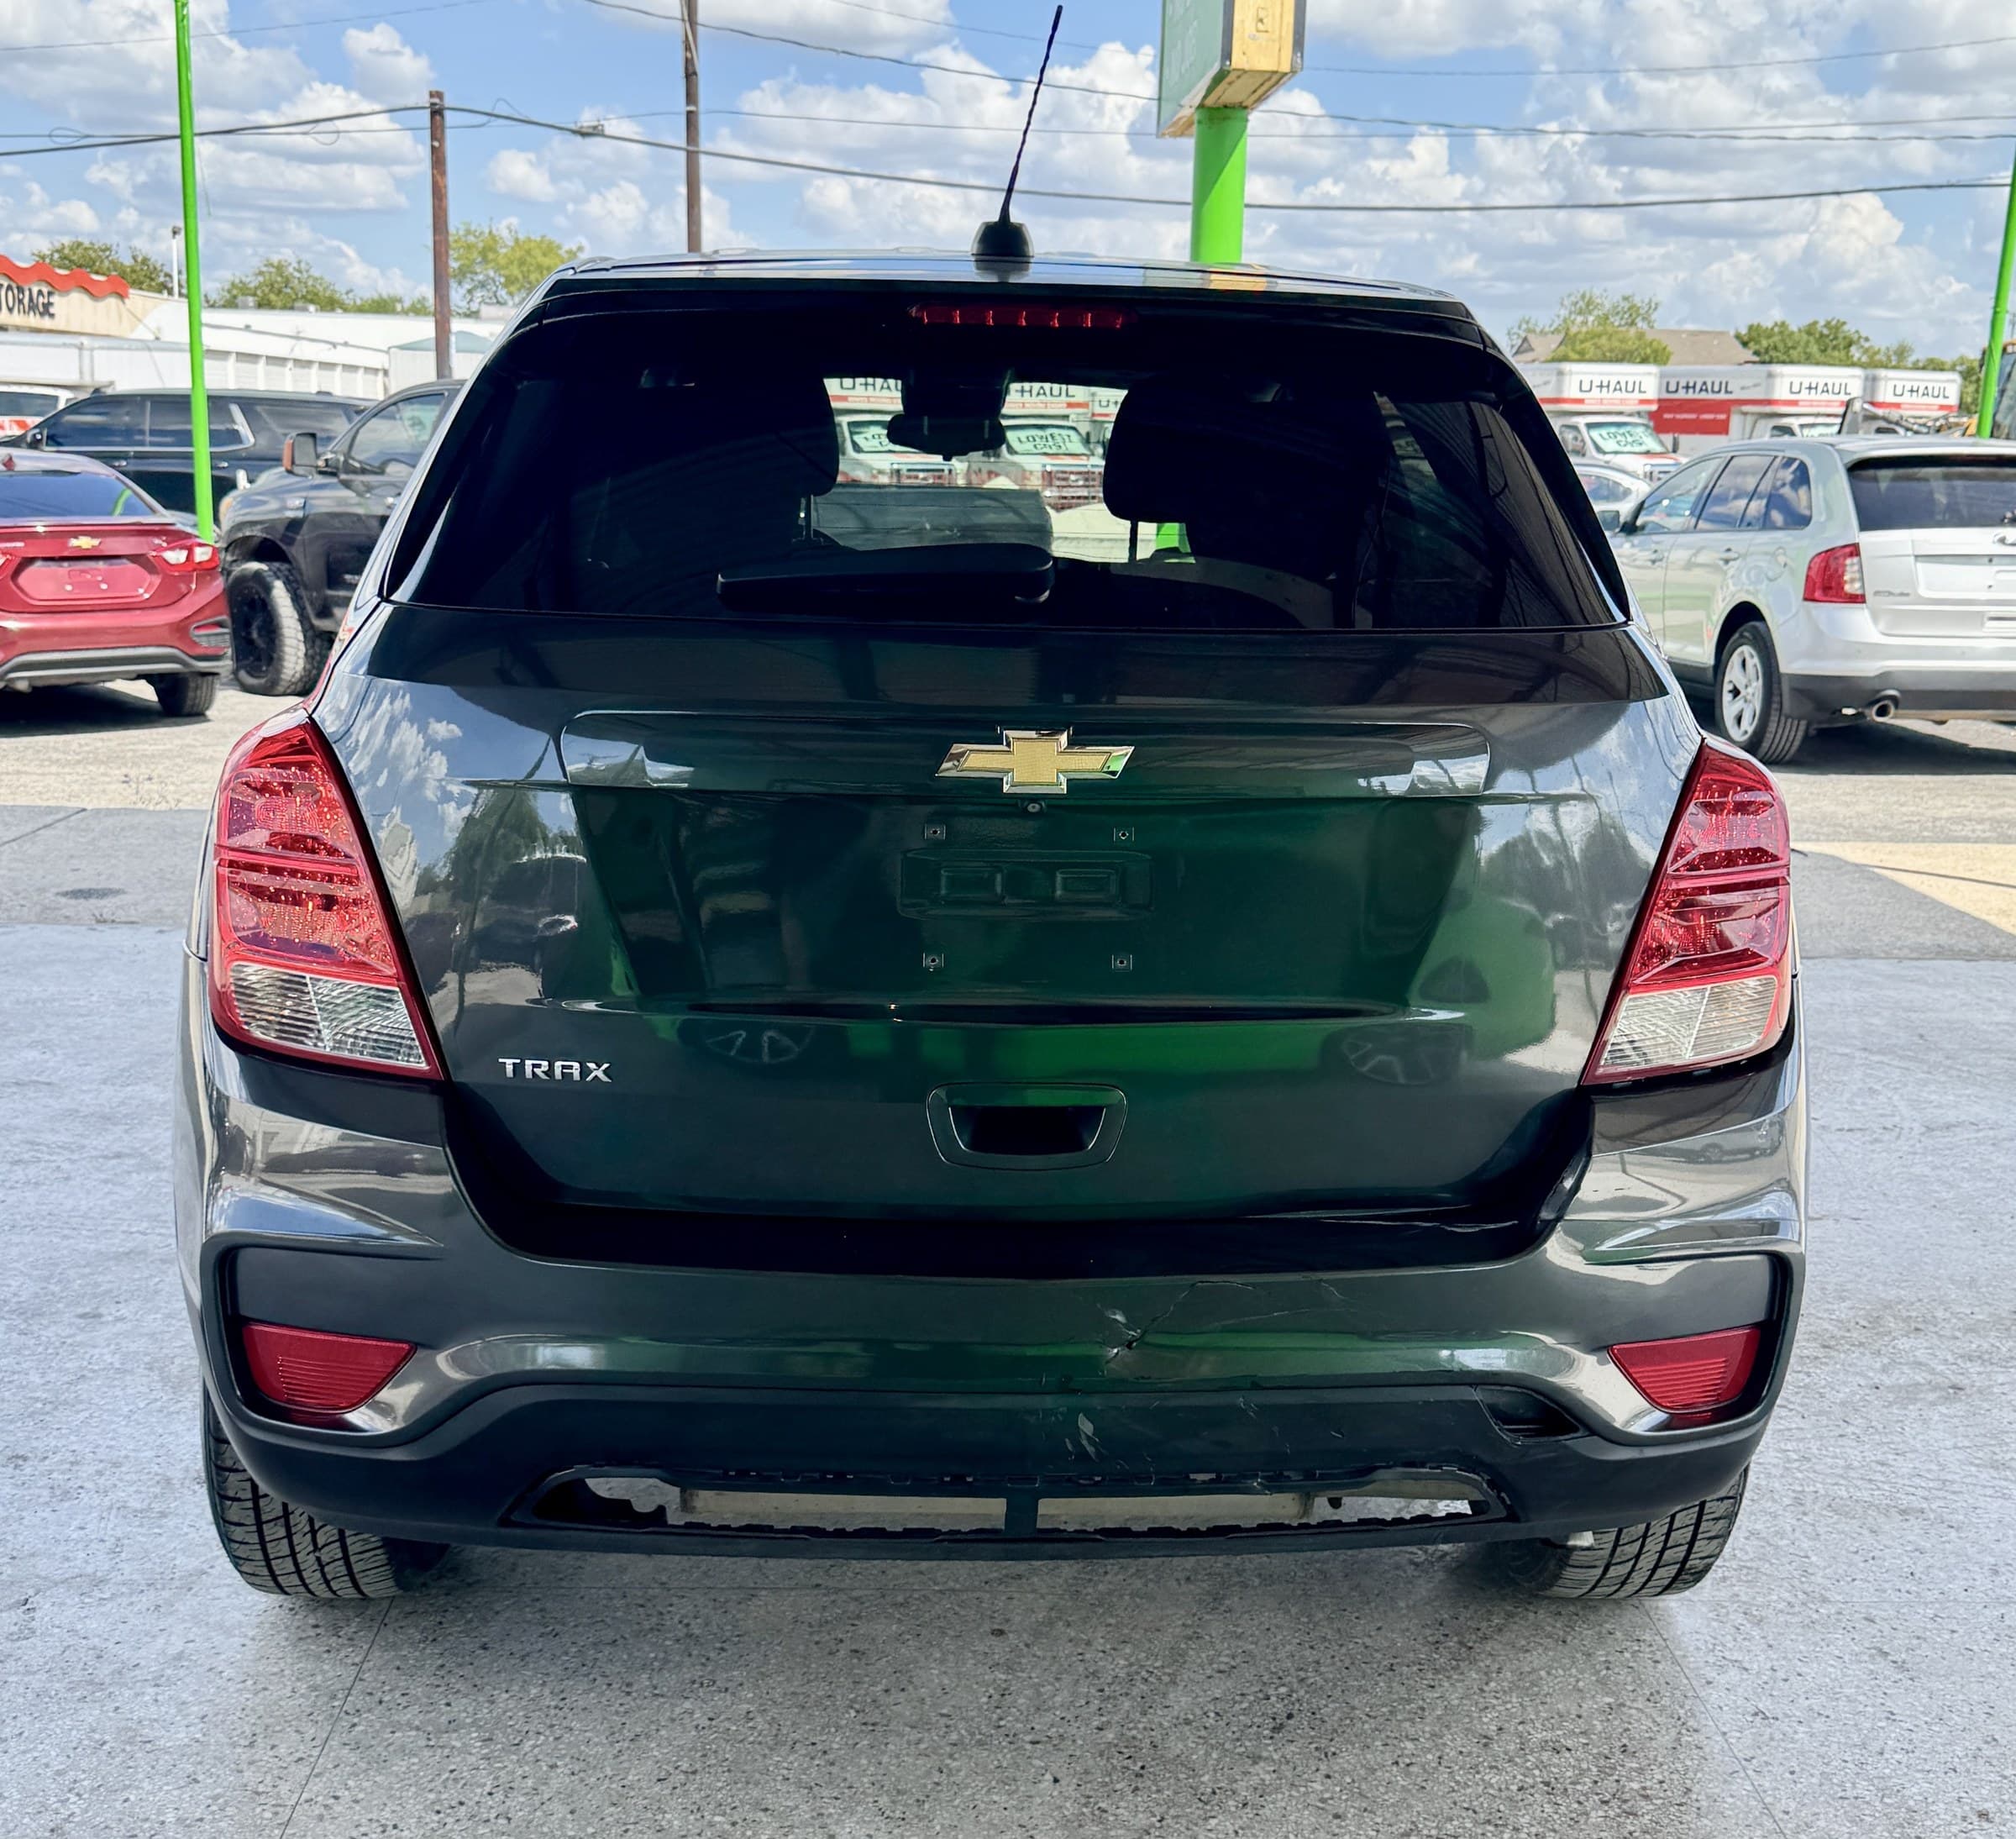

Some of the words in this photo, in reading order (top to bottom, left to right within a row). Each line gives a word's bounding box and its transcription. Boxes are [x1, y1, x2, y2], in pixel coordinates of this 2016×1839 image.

[840, 378, 901, 391] U-HAU
[1008, 385, 1075, 397] -HAUL
[1579, 379, 1647, 394] U-HAUL
[1665, 381, 1734, 395] U-HAUL
[1789, 381, 1851, 395] U-HAUL
[1893, 384, 1950, 399] U-HAUL
[498, 1058, 612, 1083] TRAX
